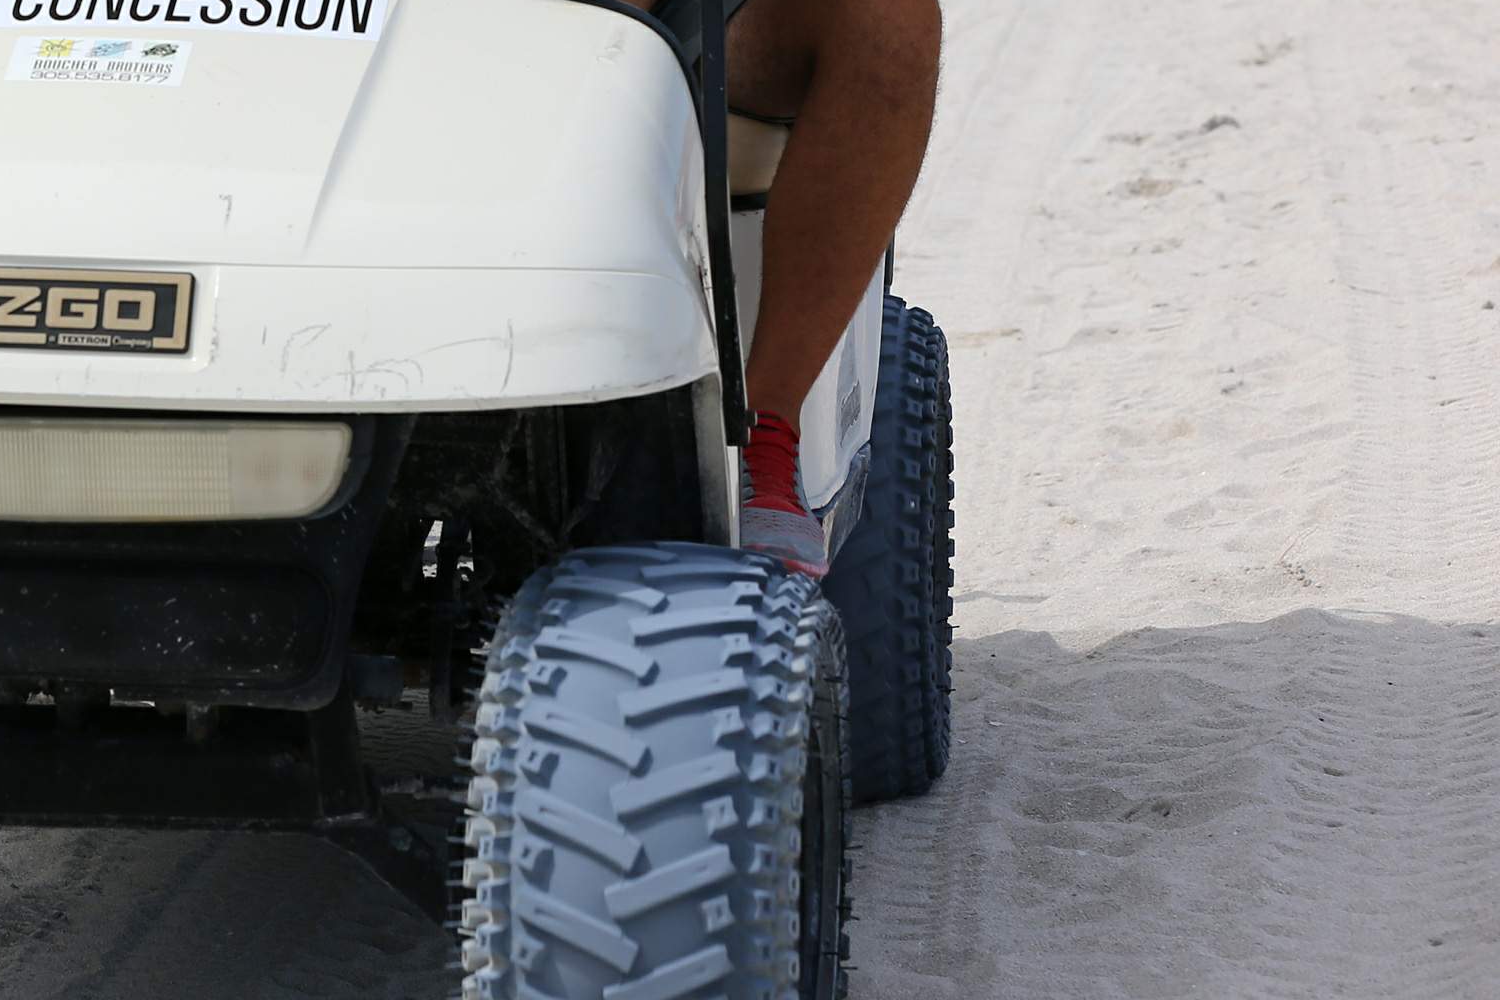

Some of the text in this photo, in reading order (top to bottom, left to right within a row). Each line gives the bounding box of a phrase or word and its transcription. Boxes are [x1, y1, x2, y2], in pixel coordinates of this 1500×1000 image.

[33, 59, 173, 73] BOUCHER BROTHERS
[61, 335, 110, 345] TEXTRON
